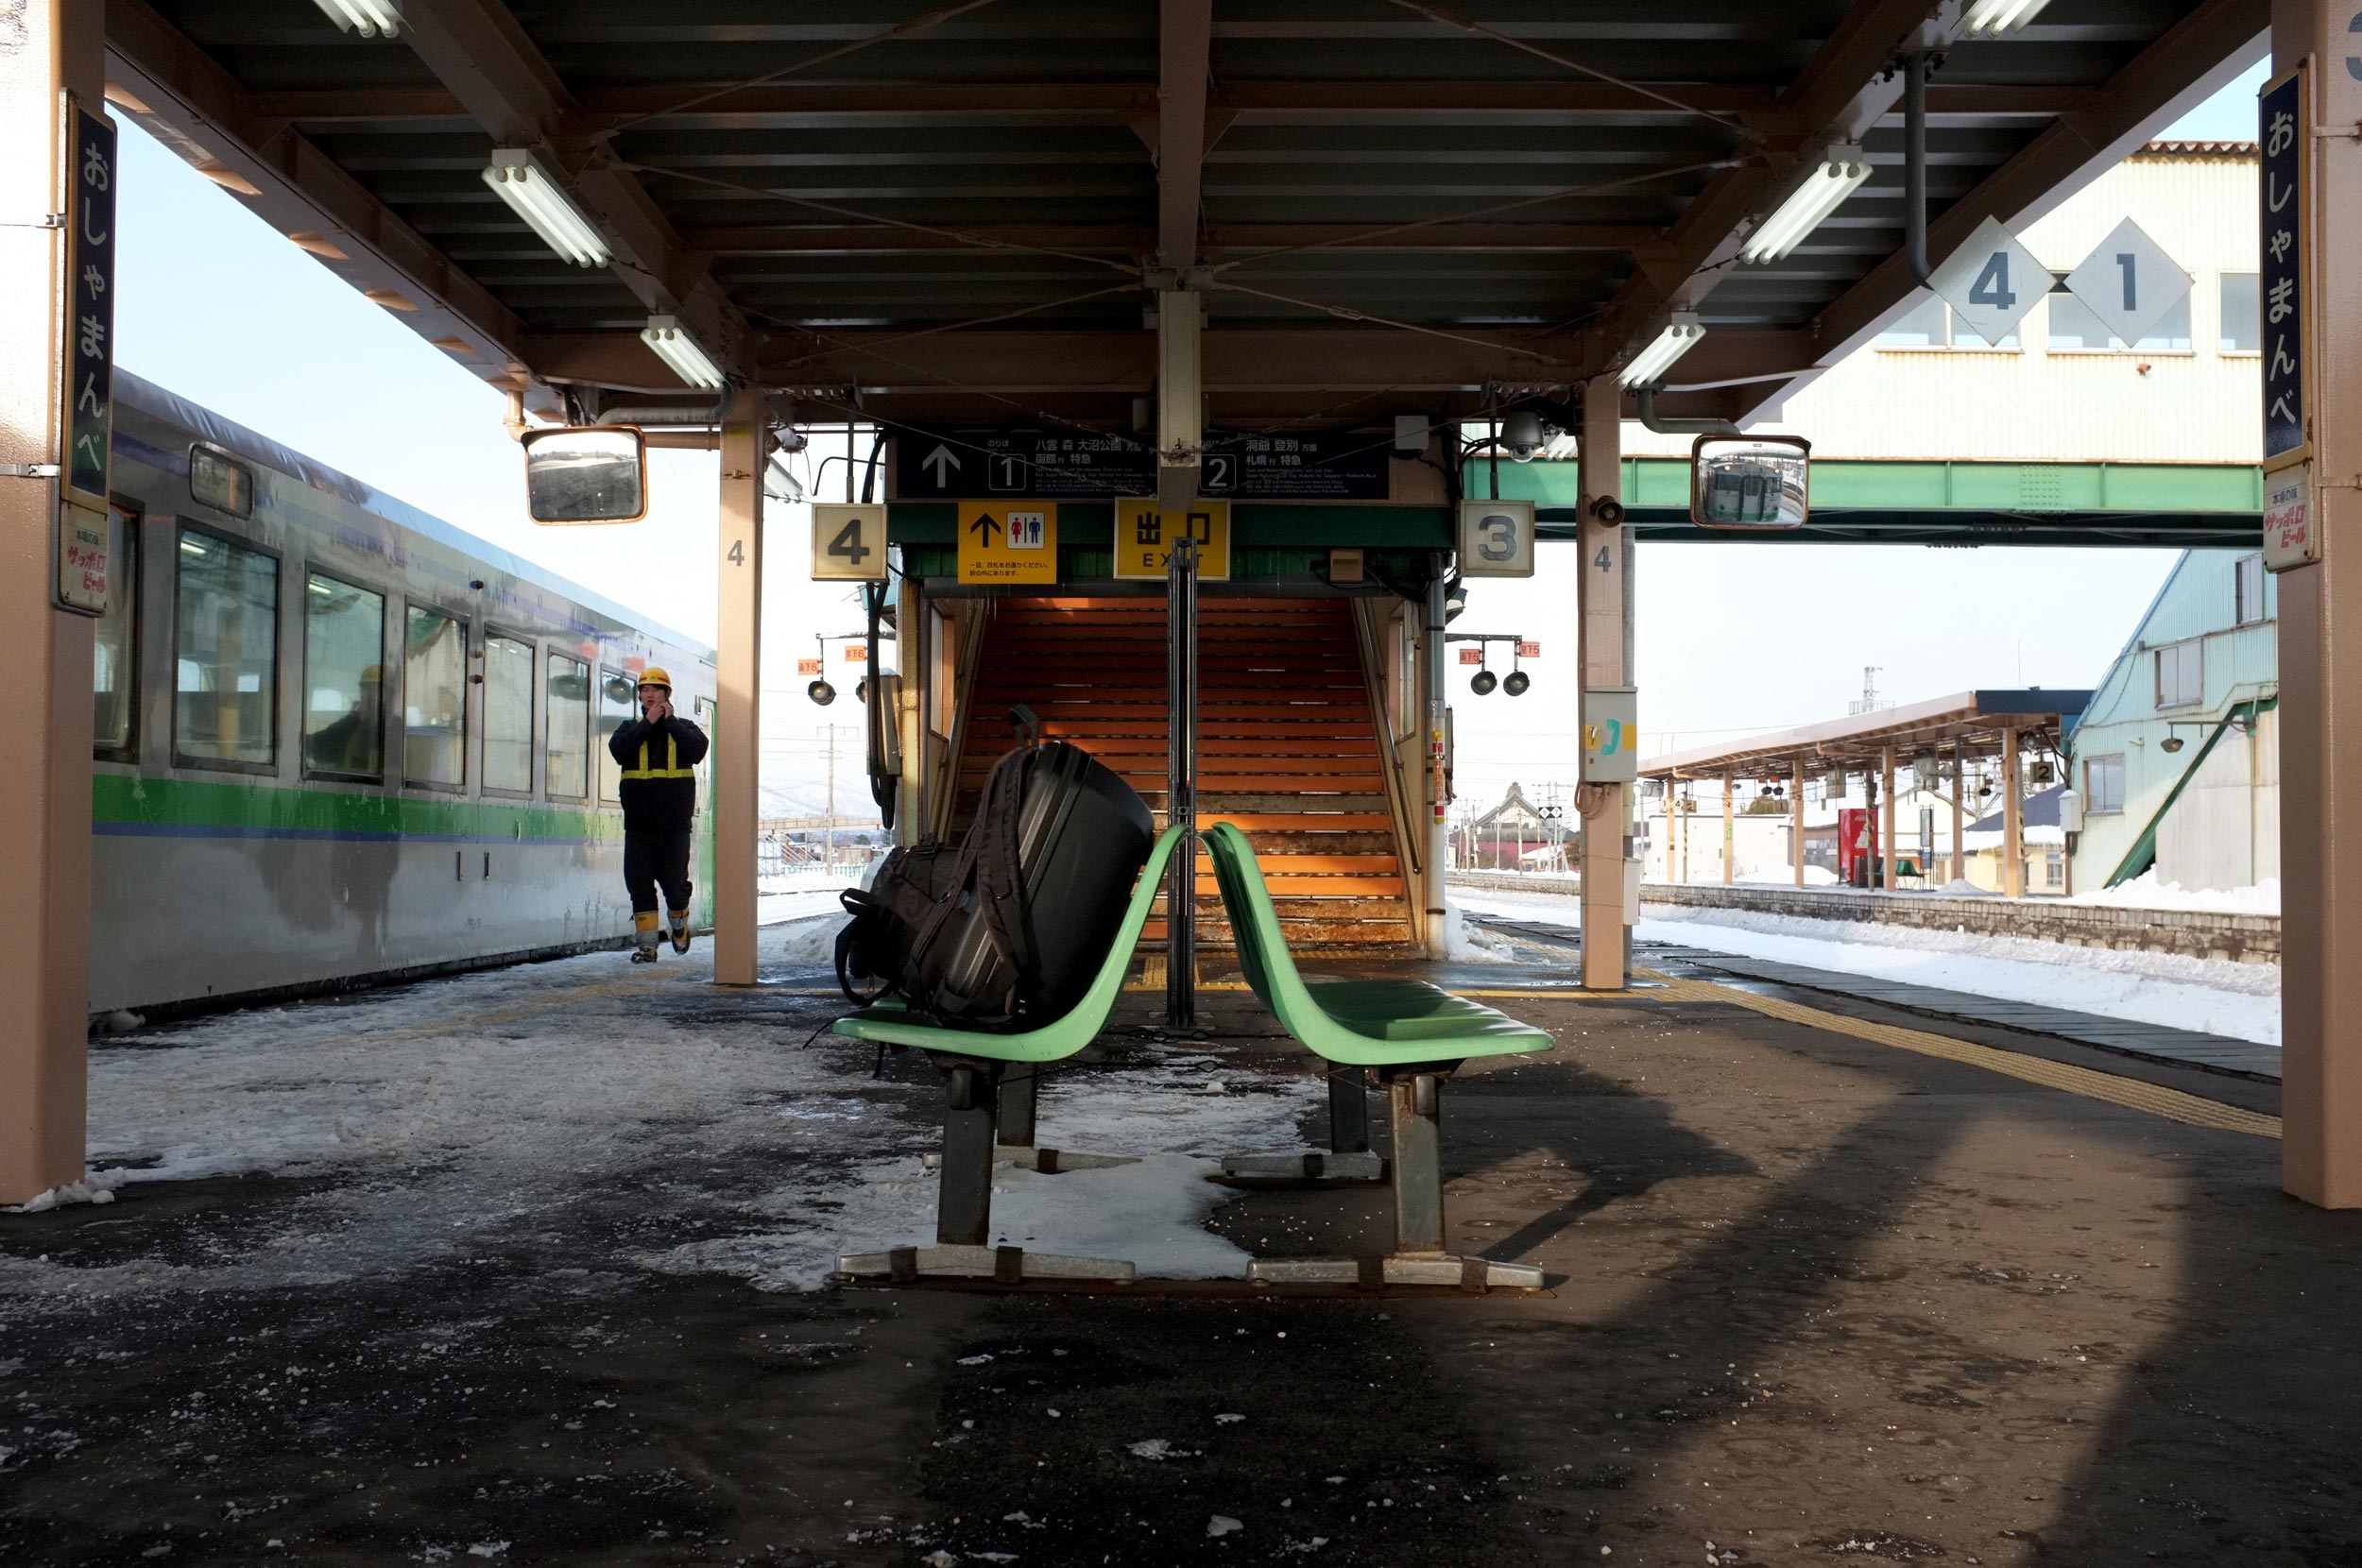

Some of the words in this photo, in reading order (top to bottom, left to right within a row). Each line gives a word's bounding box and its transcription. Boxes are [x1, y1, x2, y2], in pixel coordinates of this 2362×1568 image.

[1969, 251, 2016, 310] 4
[2268, 111, 2297, 424] おしゃまんべ
[2115, 253, 2136, 311] 1
[77, 142, 109, 472] おしゃまんべ
[987, 439, 1010, 448] のりば
[1036, 439, 1058, 452] 八雲
[1061, 439, 1073, 452] 森
[1077, 439, 1121, 452] 大沼公園
[1245, 439, 1270, 452] 洞爺
[1274, 439, 1298, 452] 登別
[1001, 457, 1013, 486] 1
[1036, 453, 1056, 464] 函館
[1070, 453, 1091, 464] 特急
[1208, 458, 1227, 486] 2
[1245, 455, 1267, 466] 札幌
[1280, 455, 1301, 466] 特急
[1137, 512, 1210, 545] 出口
[2265, 504, 2305, 532] サッポロ
[827, 519, 870, 565] 4
[1478, 515, 1517, 561] 3
[2281, 525, 2306, 549] ビール
[68, 546, 107, 572] サッポロ
[727, 539, 745, 567] 4
[1143, 553, 1203, 568] EXT
[1594, 545, 1612, 573] 4
[83, 571, 107, 594] ビール
[2038, 765, 2049, 779] 2
